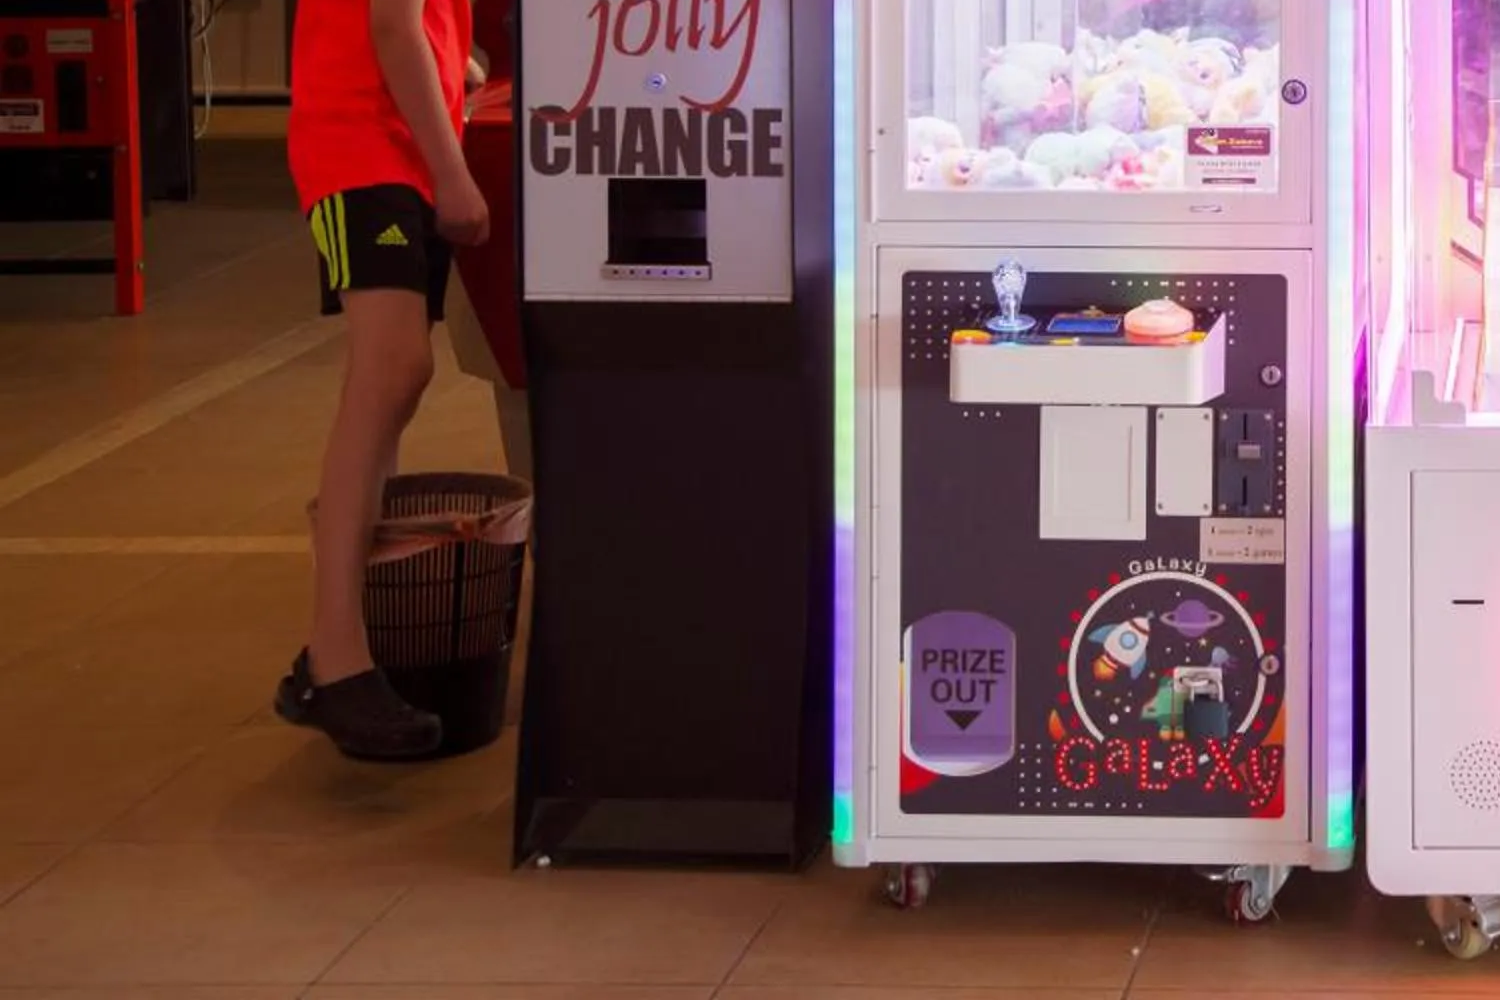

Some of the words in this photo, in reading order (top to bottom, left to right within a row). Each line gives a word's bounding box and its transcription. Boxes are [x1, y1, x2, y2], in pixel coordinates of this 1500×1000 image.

[529, 105, 785, 178] CHANGE
[920, 648, 1007, 675] PRIZE
[930, 678, 997, 704] OUT
